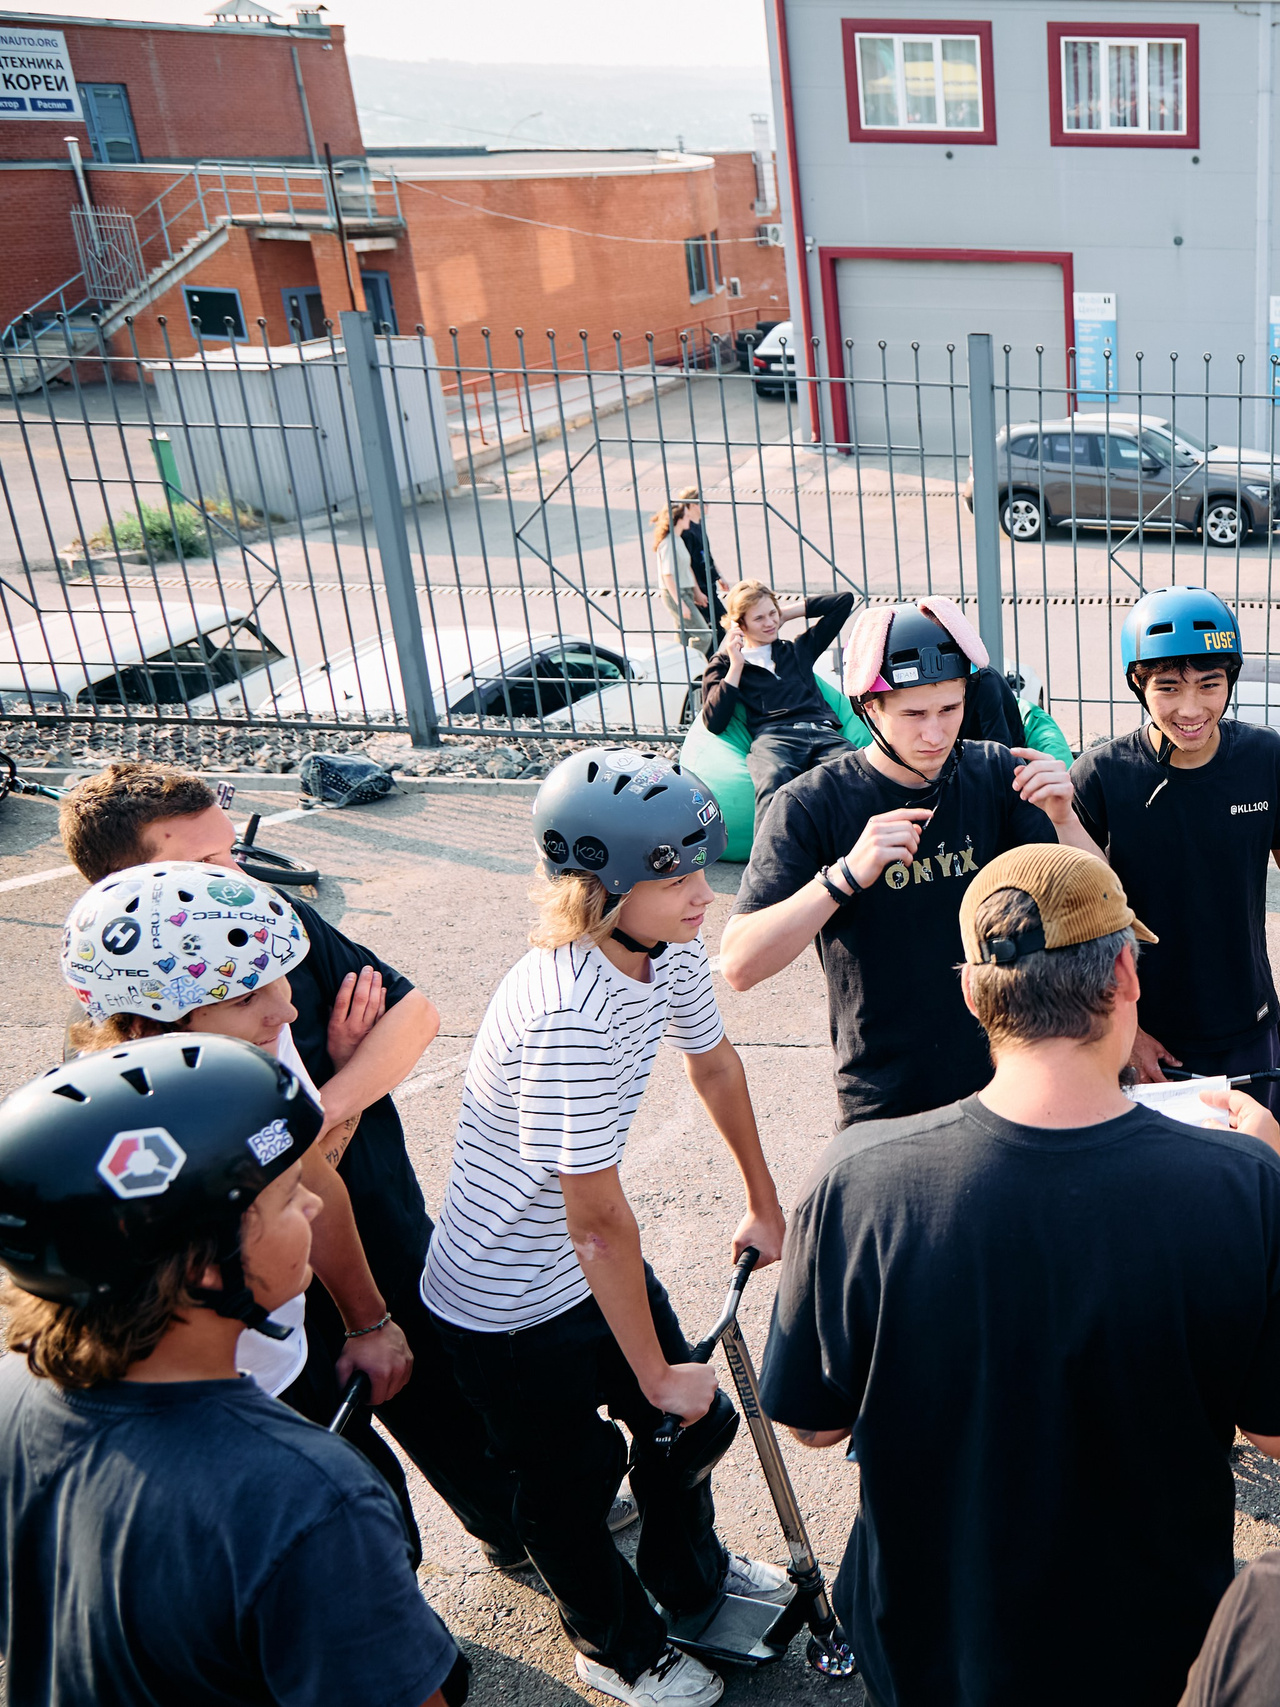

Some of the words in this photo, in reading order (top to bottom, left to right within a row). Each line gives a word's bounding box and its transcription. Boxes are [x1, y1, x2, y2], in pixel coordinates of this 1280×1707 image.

[0, 35, 59, 48] NAUTO.ORG
[2, 73, 69, 92] КОРЕИ
[36, 100, 68, 110] Распил
[575, 844, 605, 863] K24
[885, 847, 980, 890] ONYX
